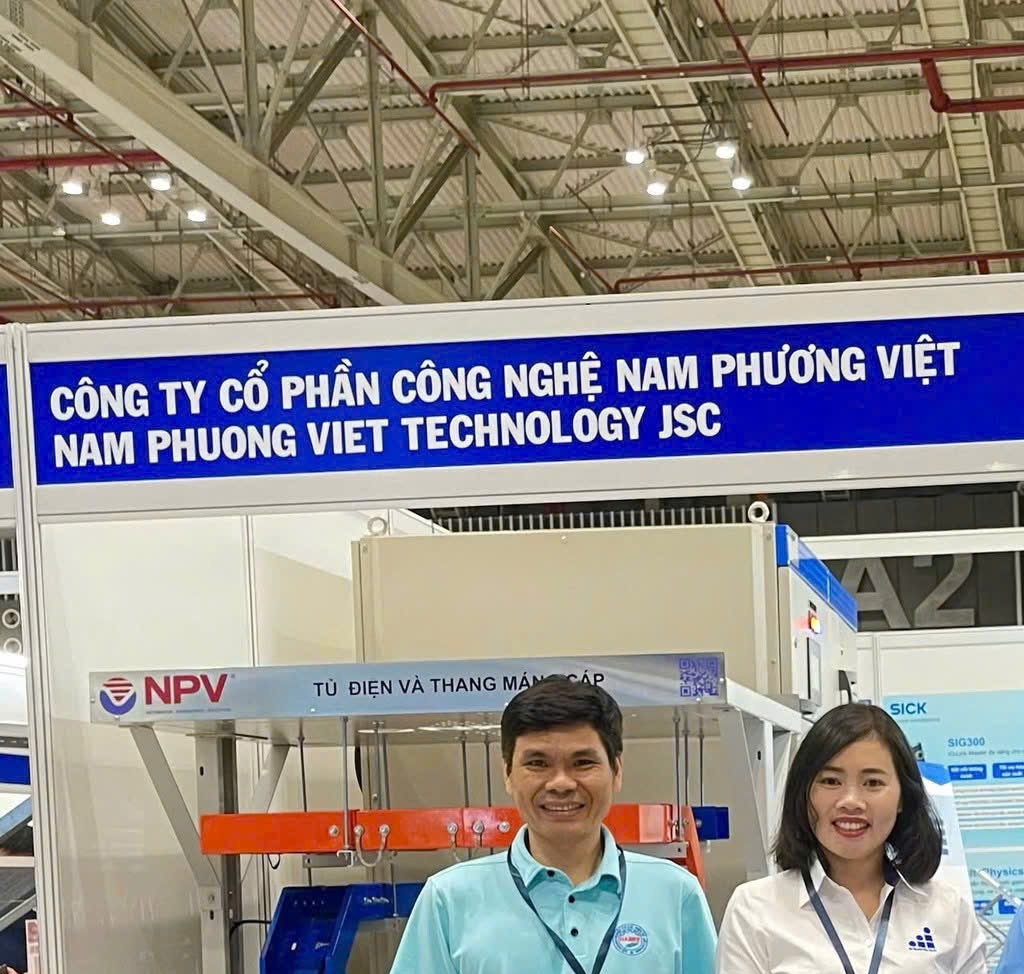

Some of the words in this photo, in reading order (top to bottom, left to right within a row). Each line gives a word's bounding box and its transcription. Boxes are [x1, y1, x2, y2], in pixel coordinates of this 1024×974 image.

[50, 376, 149, 421] CÔNG
[158, 380, 206, 415] TY
[219, 359, 269, 412] CỔ
[281, 356, 380, 409] PHẦN
[392, 359, 492, 404] CÔNG
[503, 351, 602, 402] NGHỆ
[616, 356, 699, 393] NAM
[711, 343, 867, 388] PHƯƠNG
[876, 333, 961, 386] VIỆT
[54, 431, 135, 468] NAM
[148, 423, 297, 463] PHUONG
[306, 418, 388, 456] VIET
[400, 405, 646, 451] TECHNOLOGY
[658, 402, 721, 439] JSC
[145, 673, 228, 705] NPV
[313, 677, 337, 697] TỦ
[348, 679, 393, 699] ĐIỆN
[399, 673, 425, 694] VÀ
[430, 675, 497, 693] THANG
[890, 702, 927, 715] SICK
[948, 737, 985, 748] SIG300
